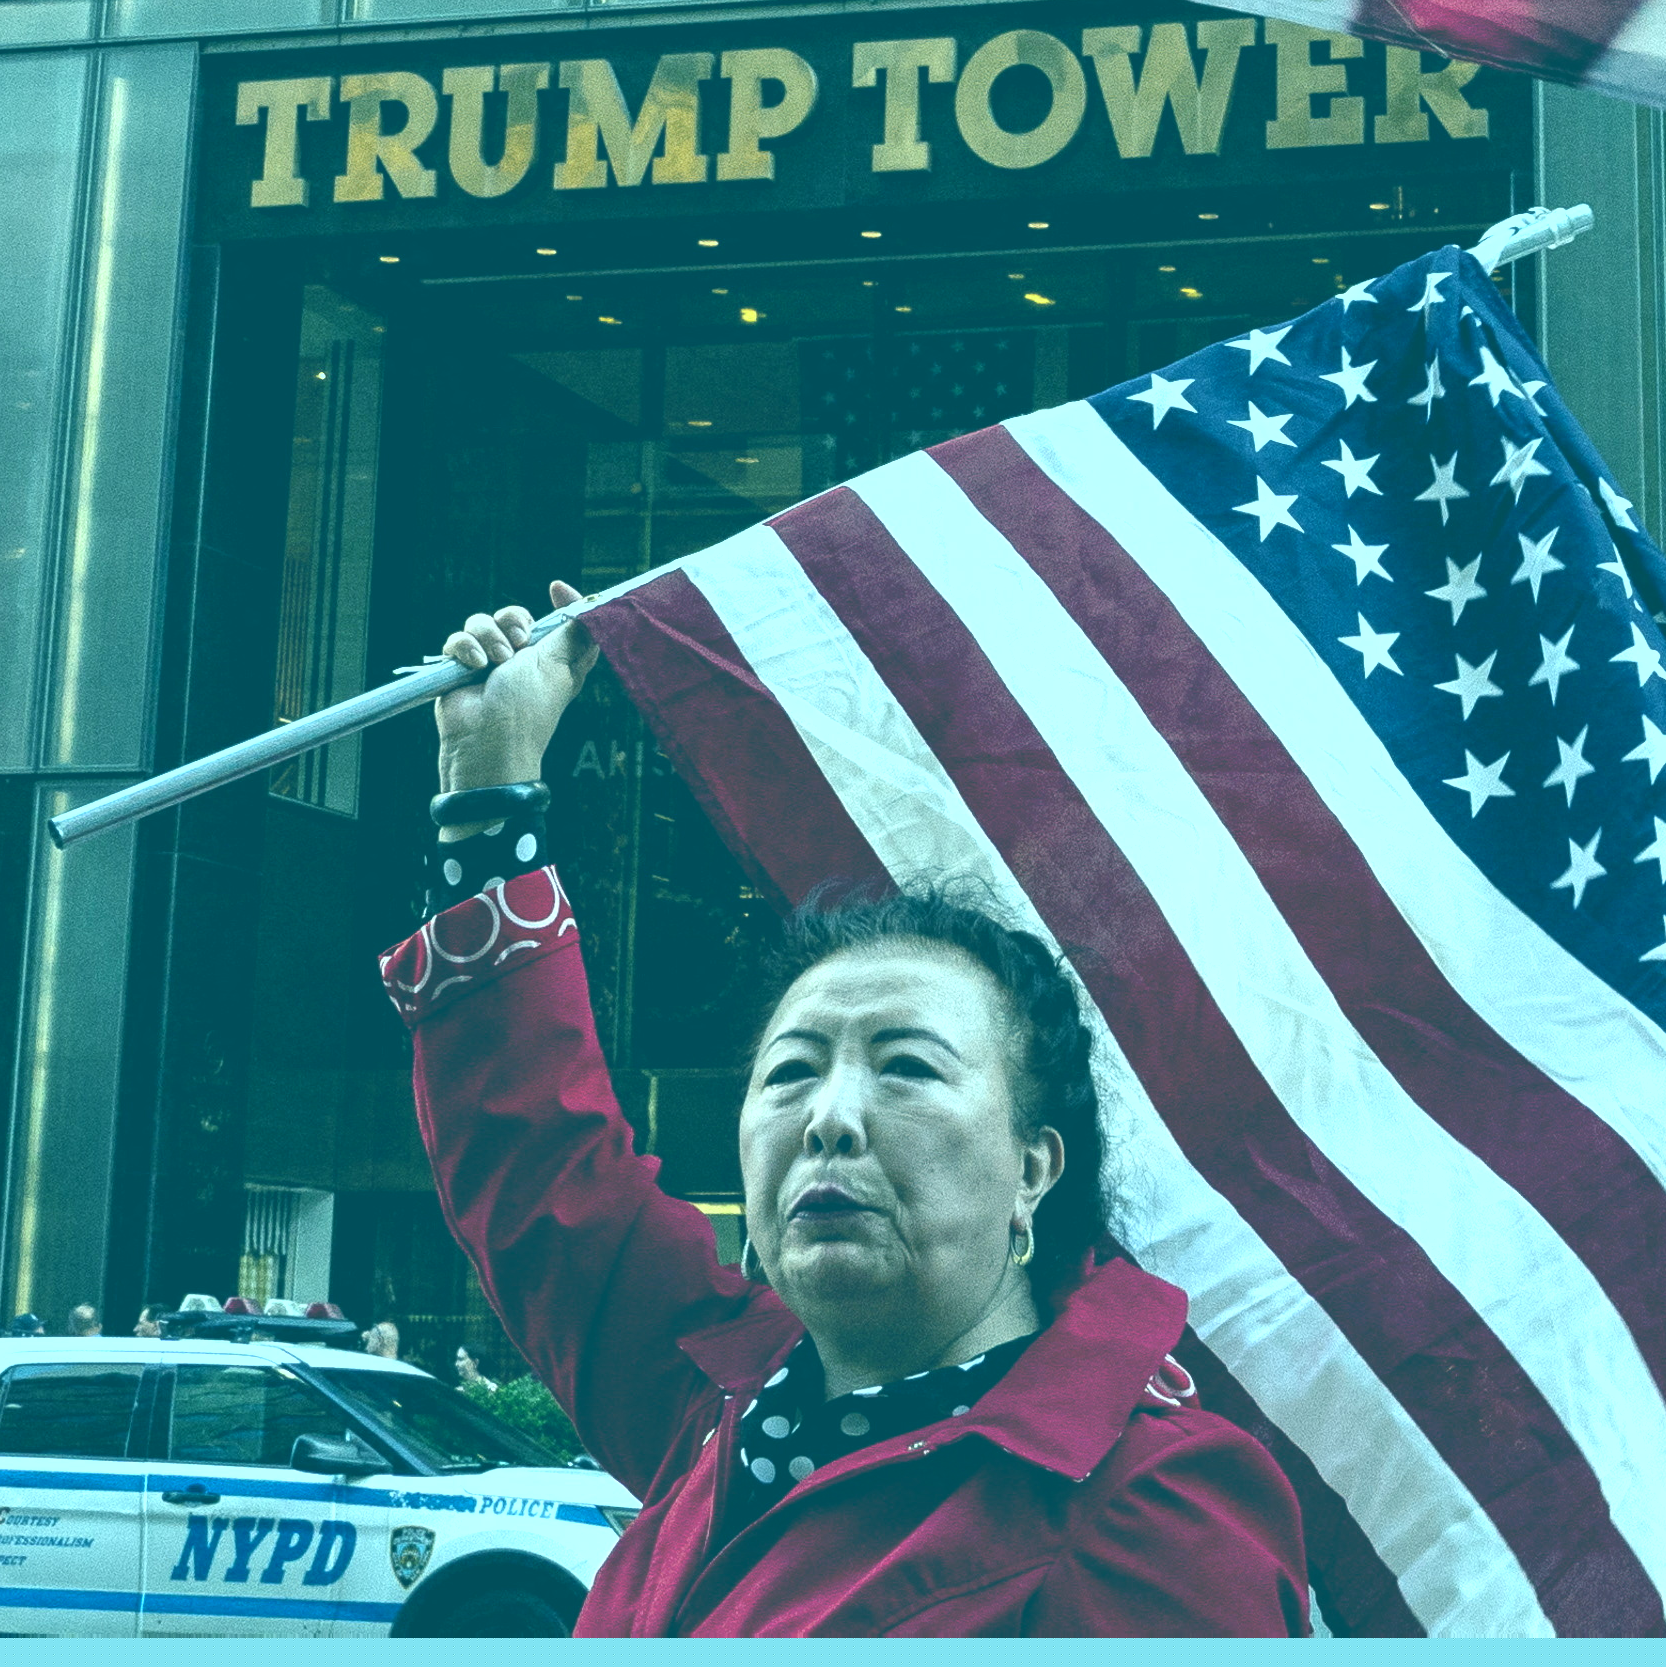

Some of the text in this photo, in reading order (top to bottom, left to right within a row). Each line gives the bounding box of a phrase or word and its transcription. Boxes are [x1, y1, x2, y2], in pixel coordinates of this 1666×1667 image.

[236, 18, 1490, 208] TRUMP TOWER
[479, 1496, 554, 1519] POLICE
[170, 1514, 357, 1586] NYPD
